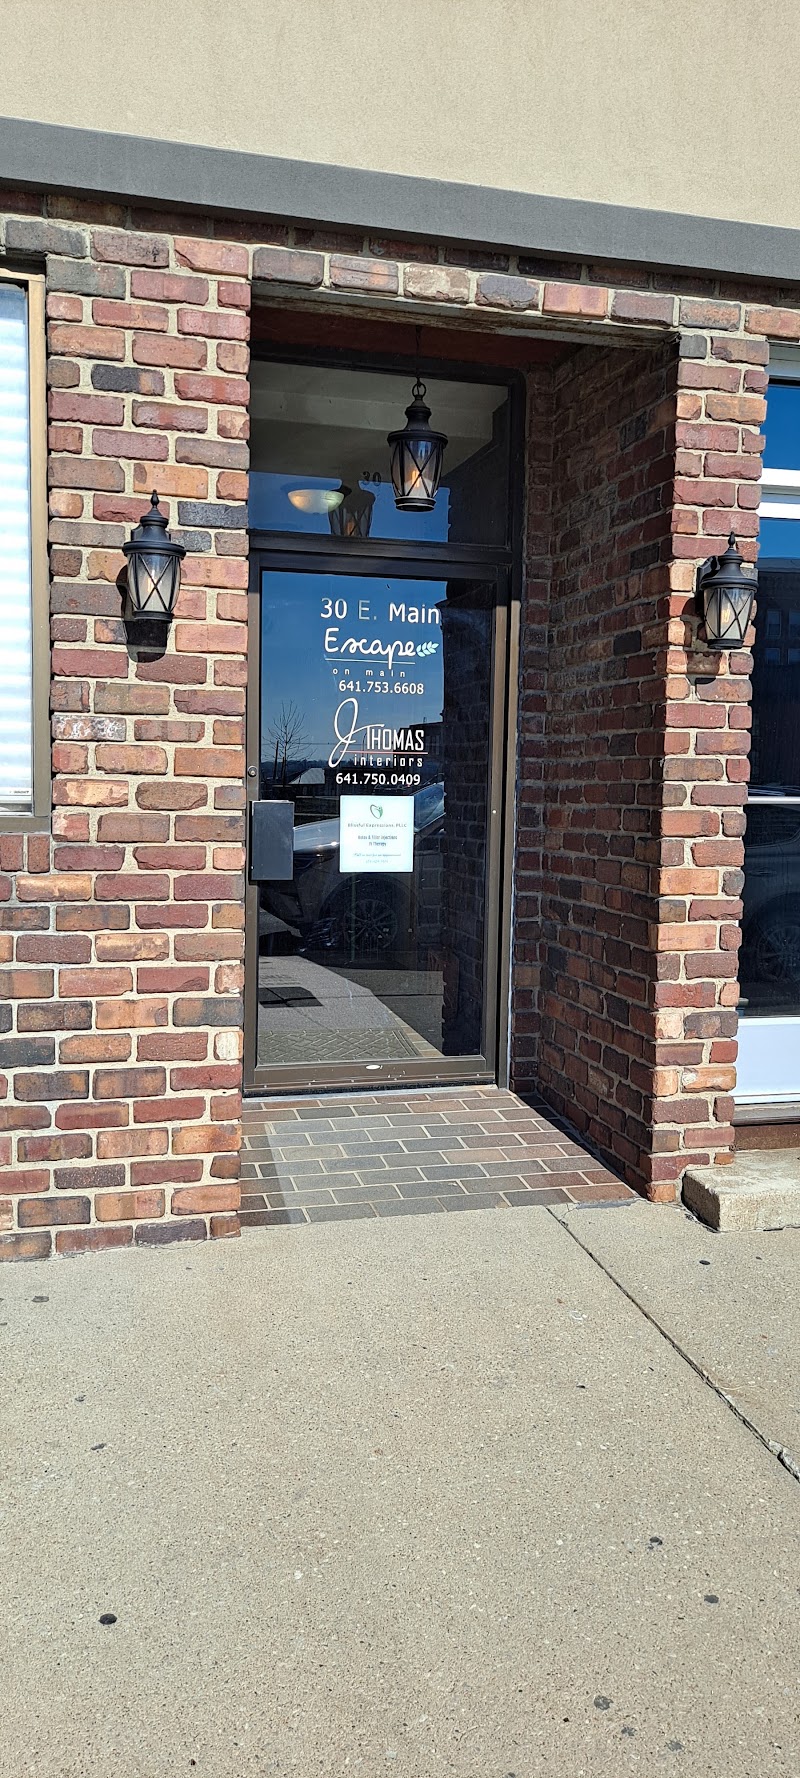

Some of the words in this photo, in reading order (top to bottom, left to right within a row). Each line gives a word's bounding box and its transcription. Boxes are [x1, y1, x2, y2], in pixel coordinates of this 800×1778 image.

[362, 471, 381, 487] 30
[320, 597, 348, 619] 30
[358, 600, 377, 620] E.
[389, 602, 440, 624] Main
[324, 627, 416, 670] Escape
[365, 668, 406, 677] main
[338, 680, 424, 695] 641.753.6608
[365, 724, 425, 751] THOMAS
[354, 754, 423, 767] interiors
[335, 773, 421, 786] 641.750.0409
